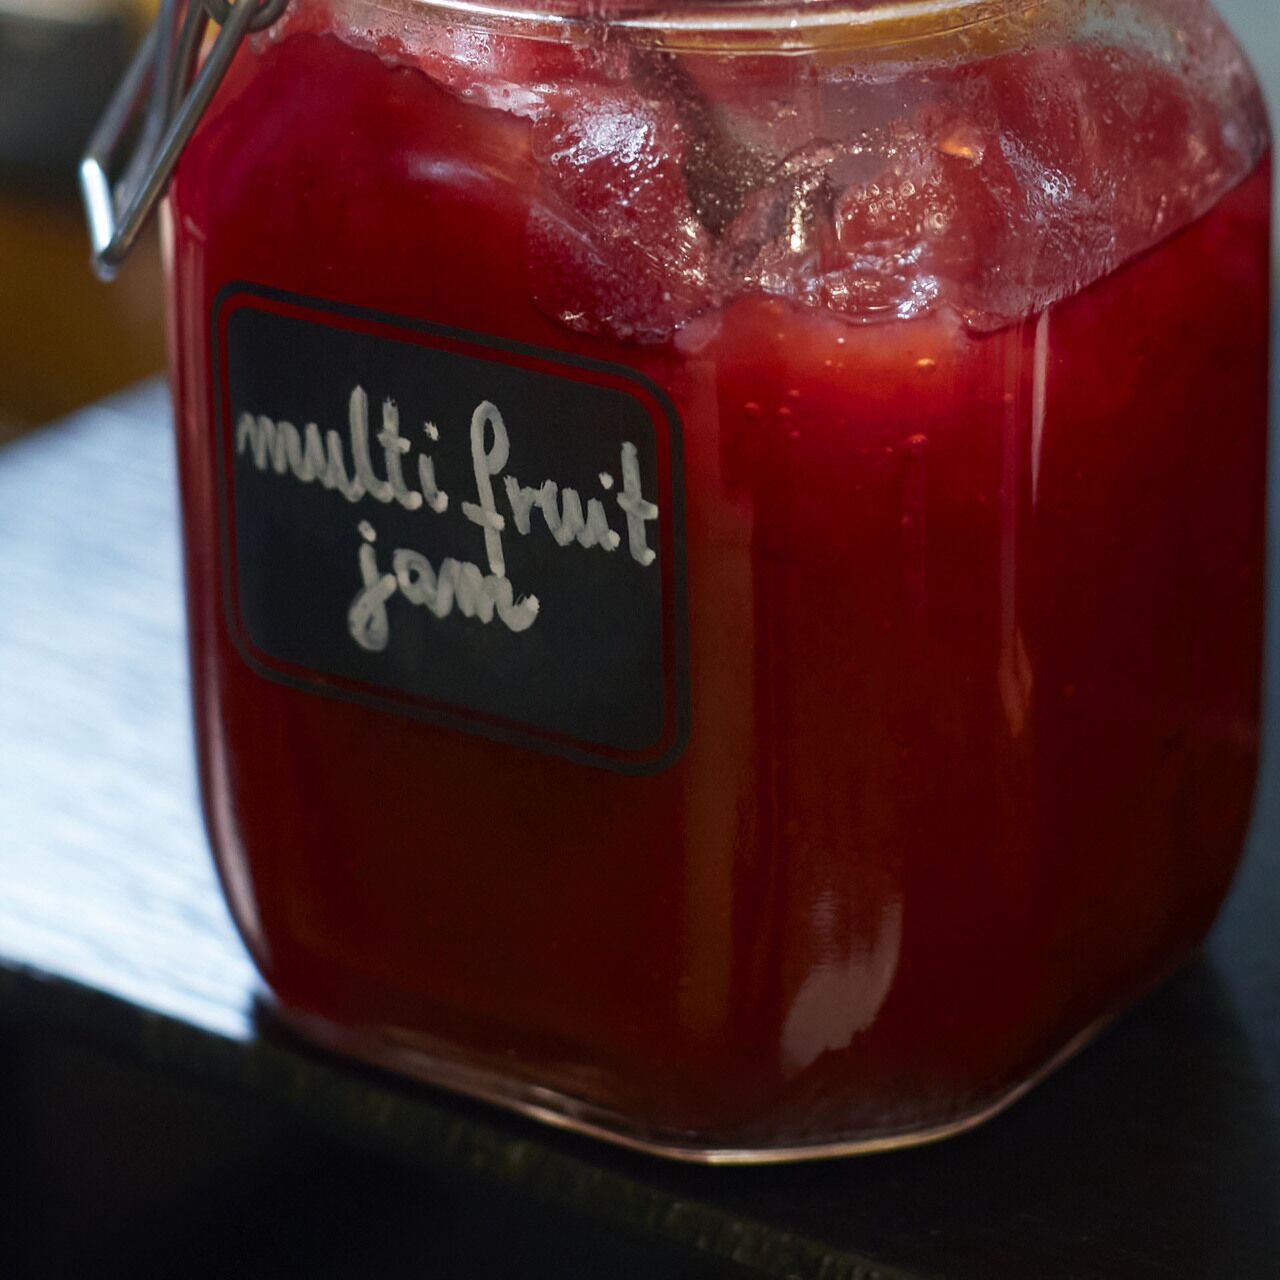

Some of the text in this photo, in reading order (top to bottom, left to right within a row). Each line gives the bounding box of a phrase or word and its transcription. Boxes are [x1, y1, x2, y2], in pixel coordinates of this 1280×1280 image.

[237, 385, 659, 575] multi fruit
[349, 521, 540, 651] jam
